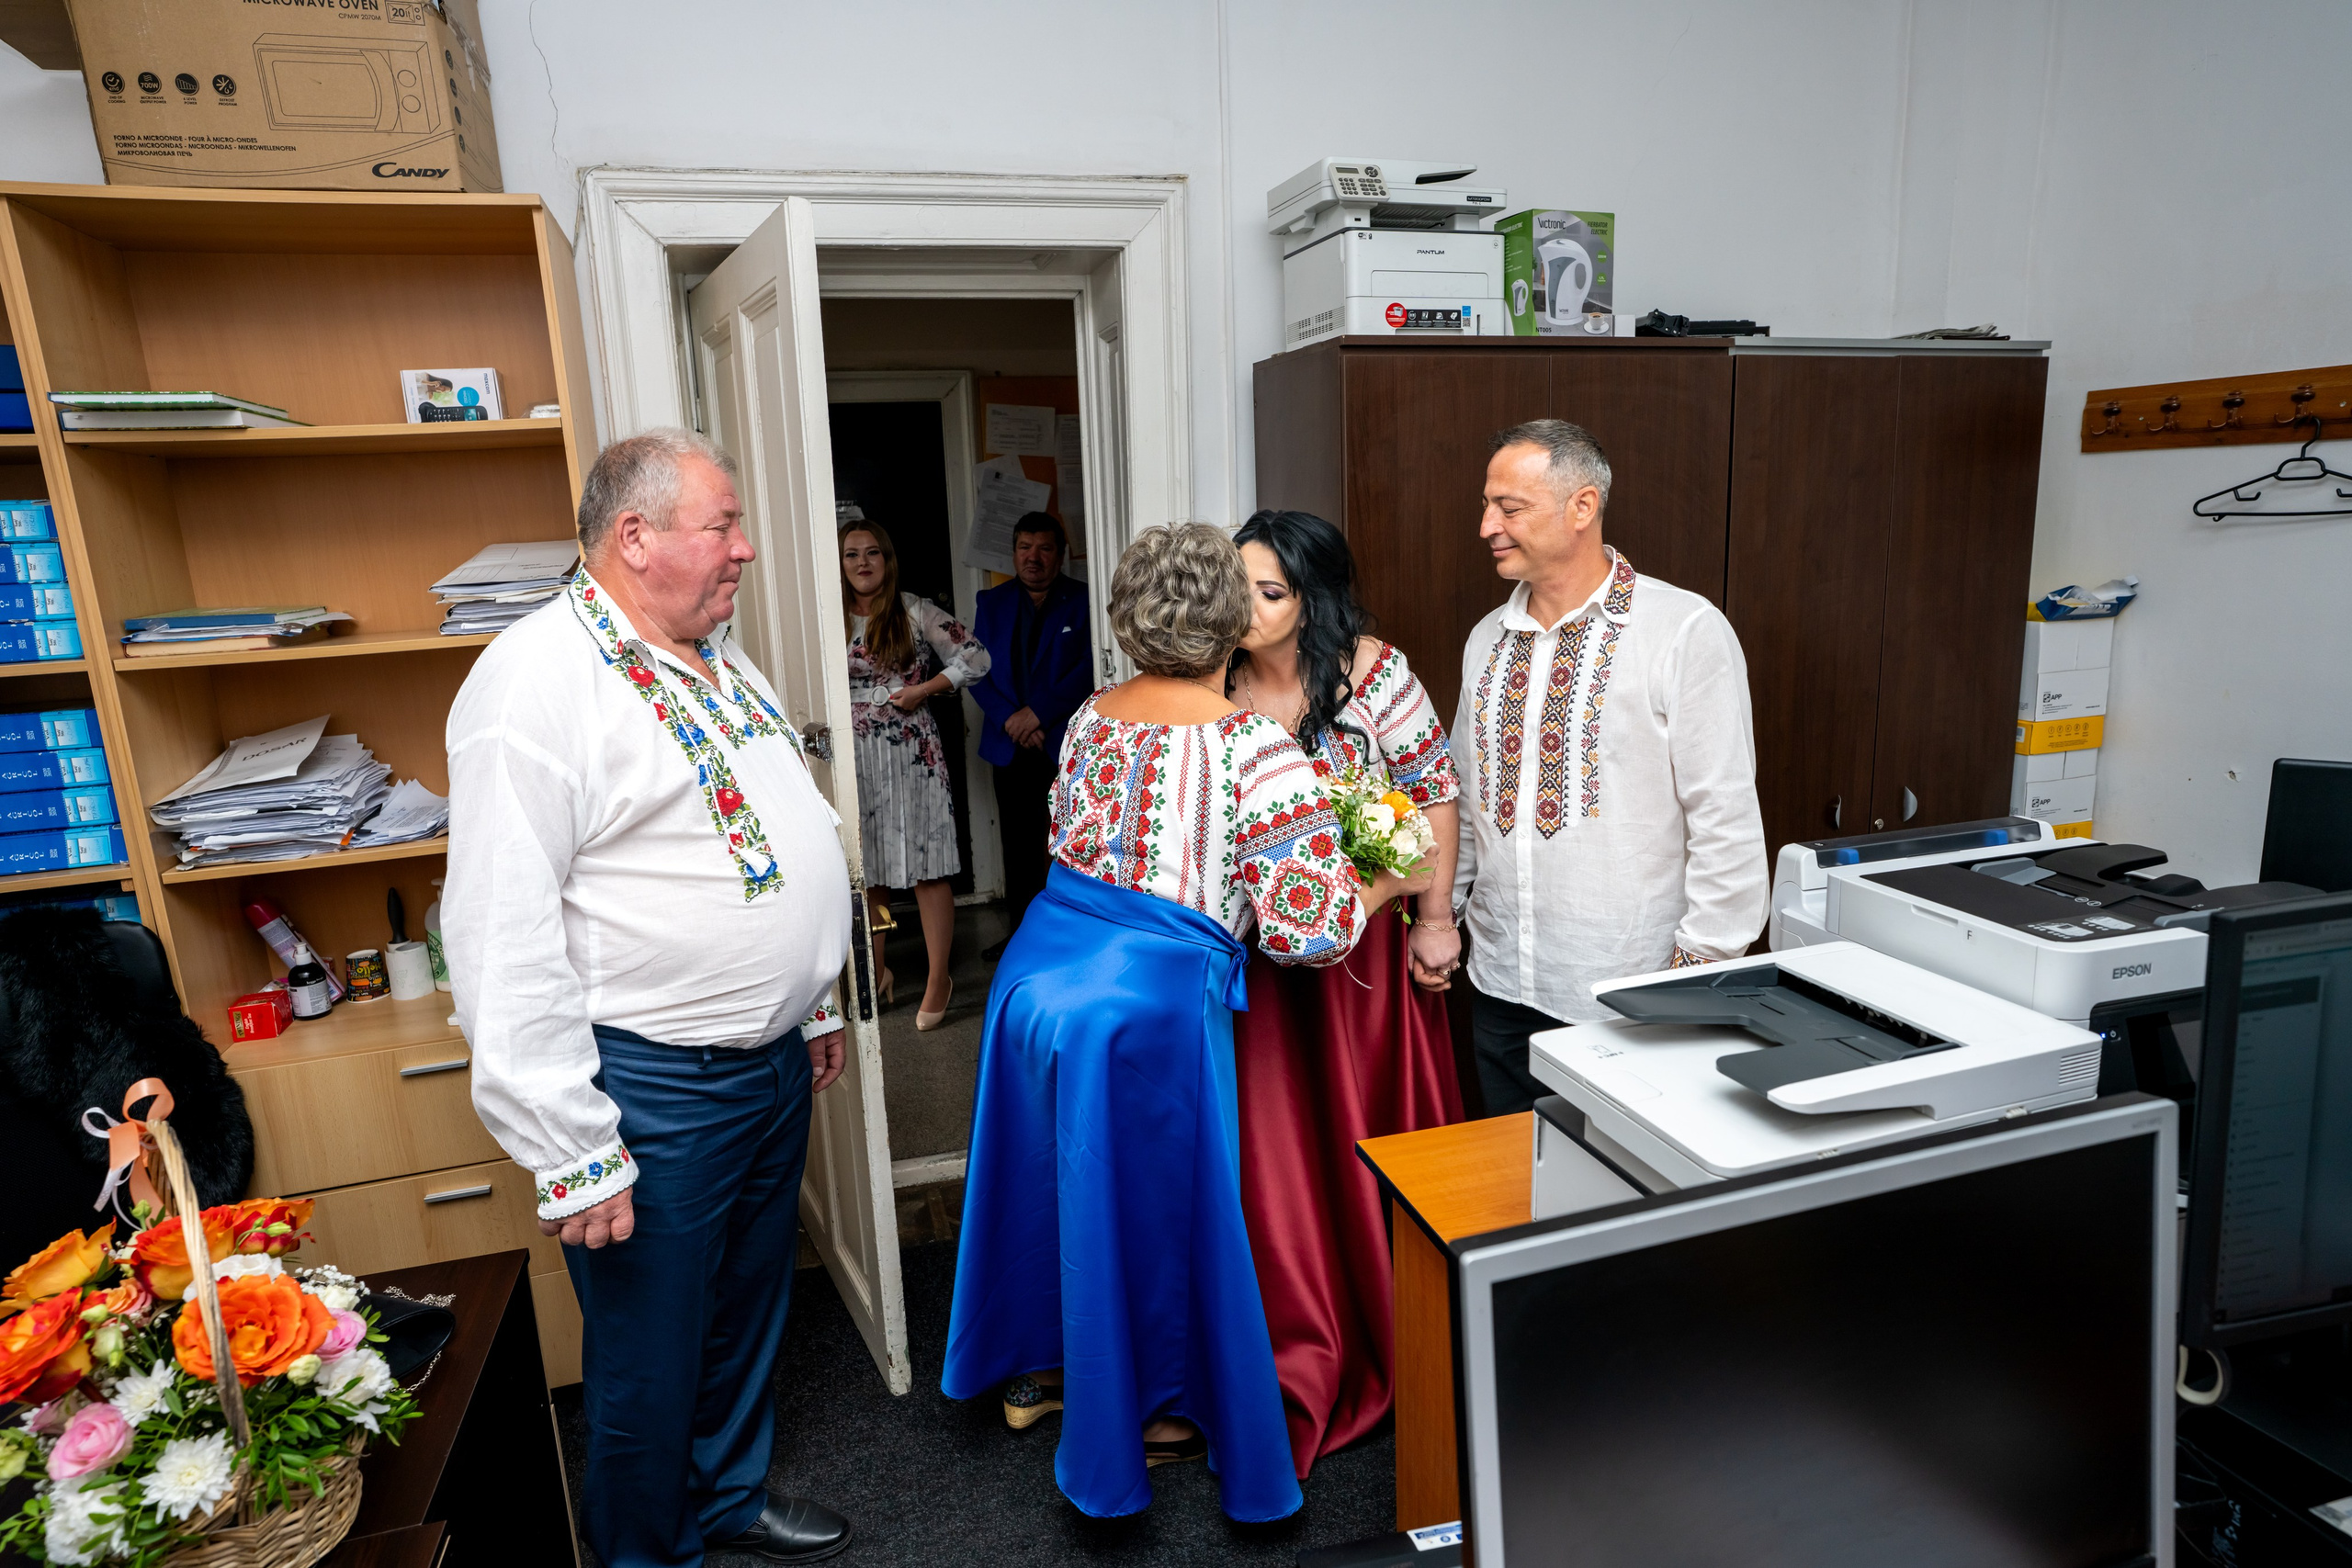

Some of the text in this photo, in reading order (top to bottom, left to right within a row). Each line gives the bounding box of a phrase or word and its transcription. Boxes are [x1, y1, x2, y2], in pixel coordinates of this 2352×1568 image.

[243, 0, 379, 10] OWAVE OVEN
[0, 732, 21, 740] ICOL
[243, 738, 307, 761] DOSAR
[2, 770, 38, 780] AGRICOL
[7, 809, 43, 819] AGRICOL
[9, 851, 44, 862] AGRICOL
[1967, 930, 1973, 940] F
[2112, 963, 2152, 980] EPSON
